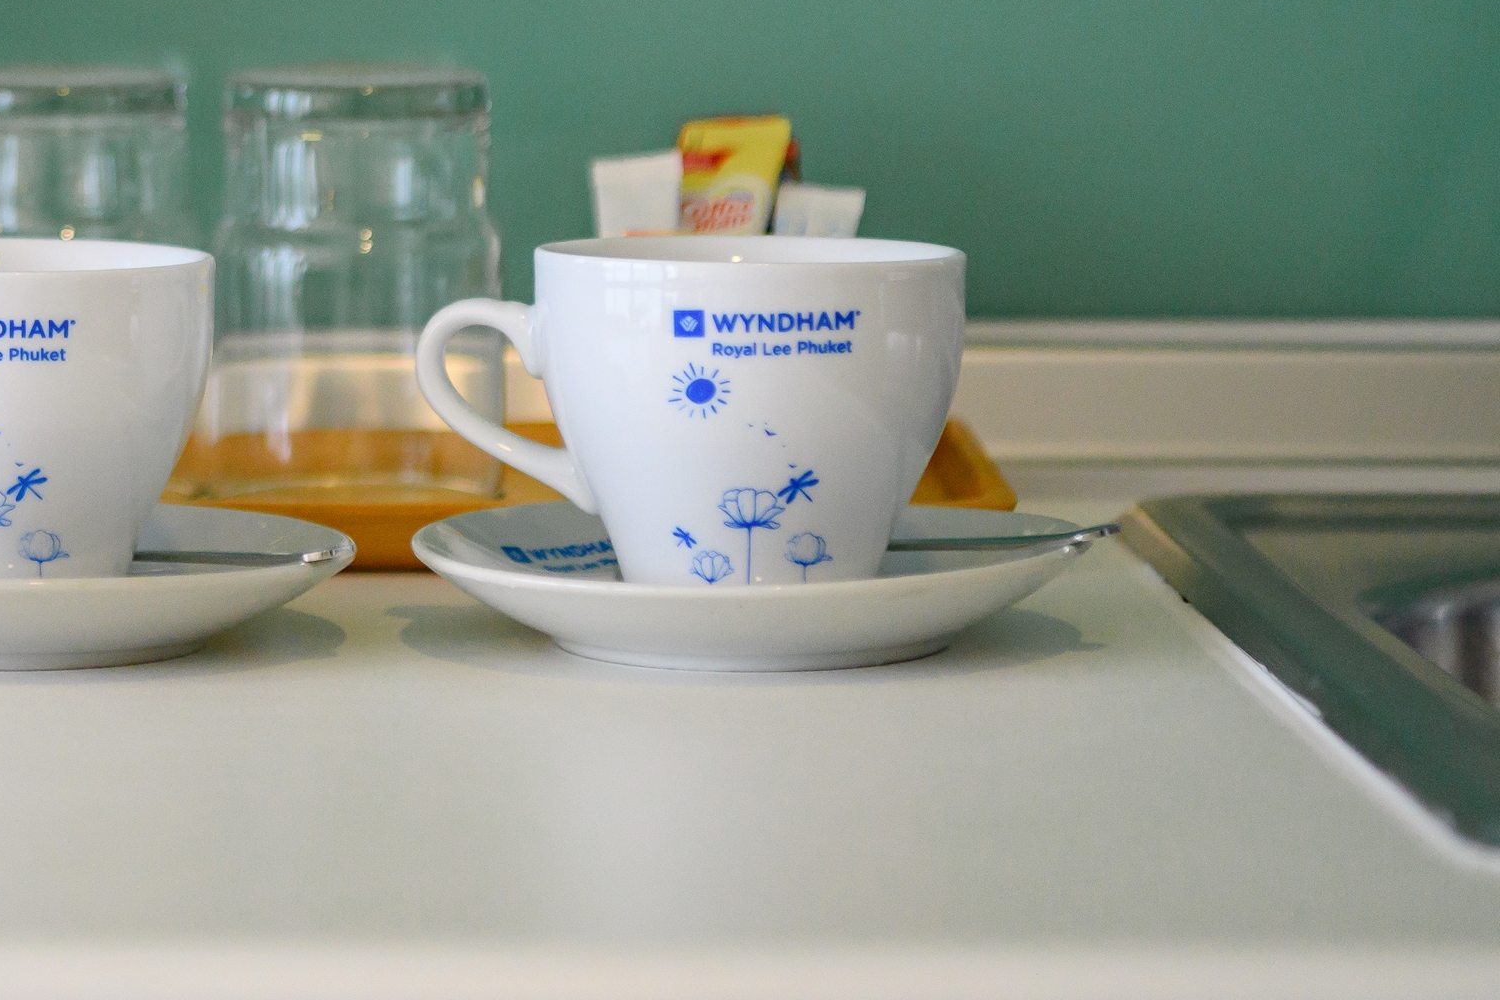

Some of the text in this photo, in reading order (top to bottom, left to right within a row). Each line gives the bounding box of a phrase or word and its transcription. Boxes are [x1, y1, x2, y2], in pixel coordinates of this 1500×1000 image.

[712, 311, 856, 333] WYNDHAM
[9, 347, 66, 361] Phuket
[712, 340, 853, 358] Royal Lee Phuket
[528, 538, 614, 560] WYNDHA
